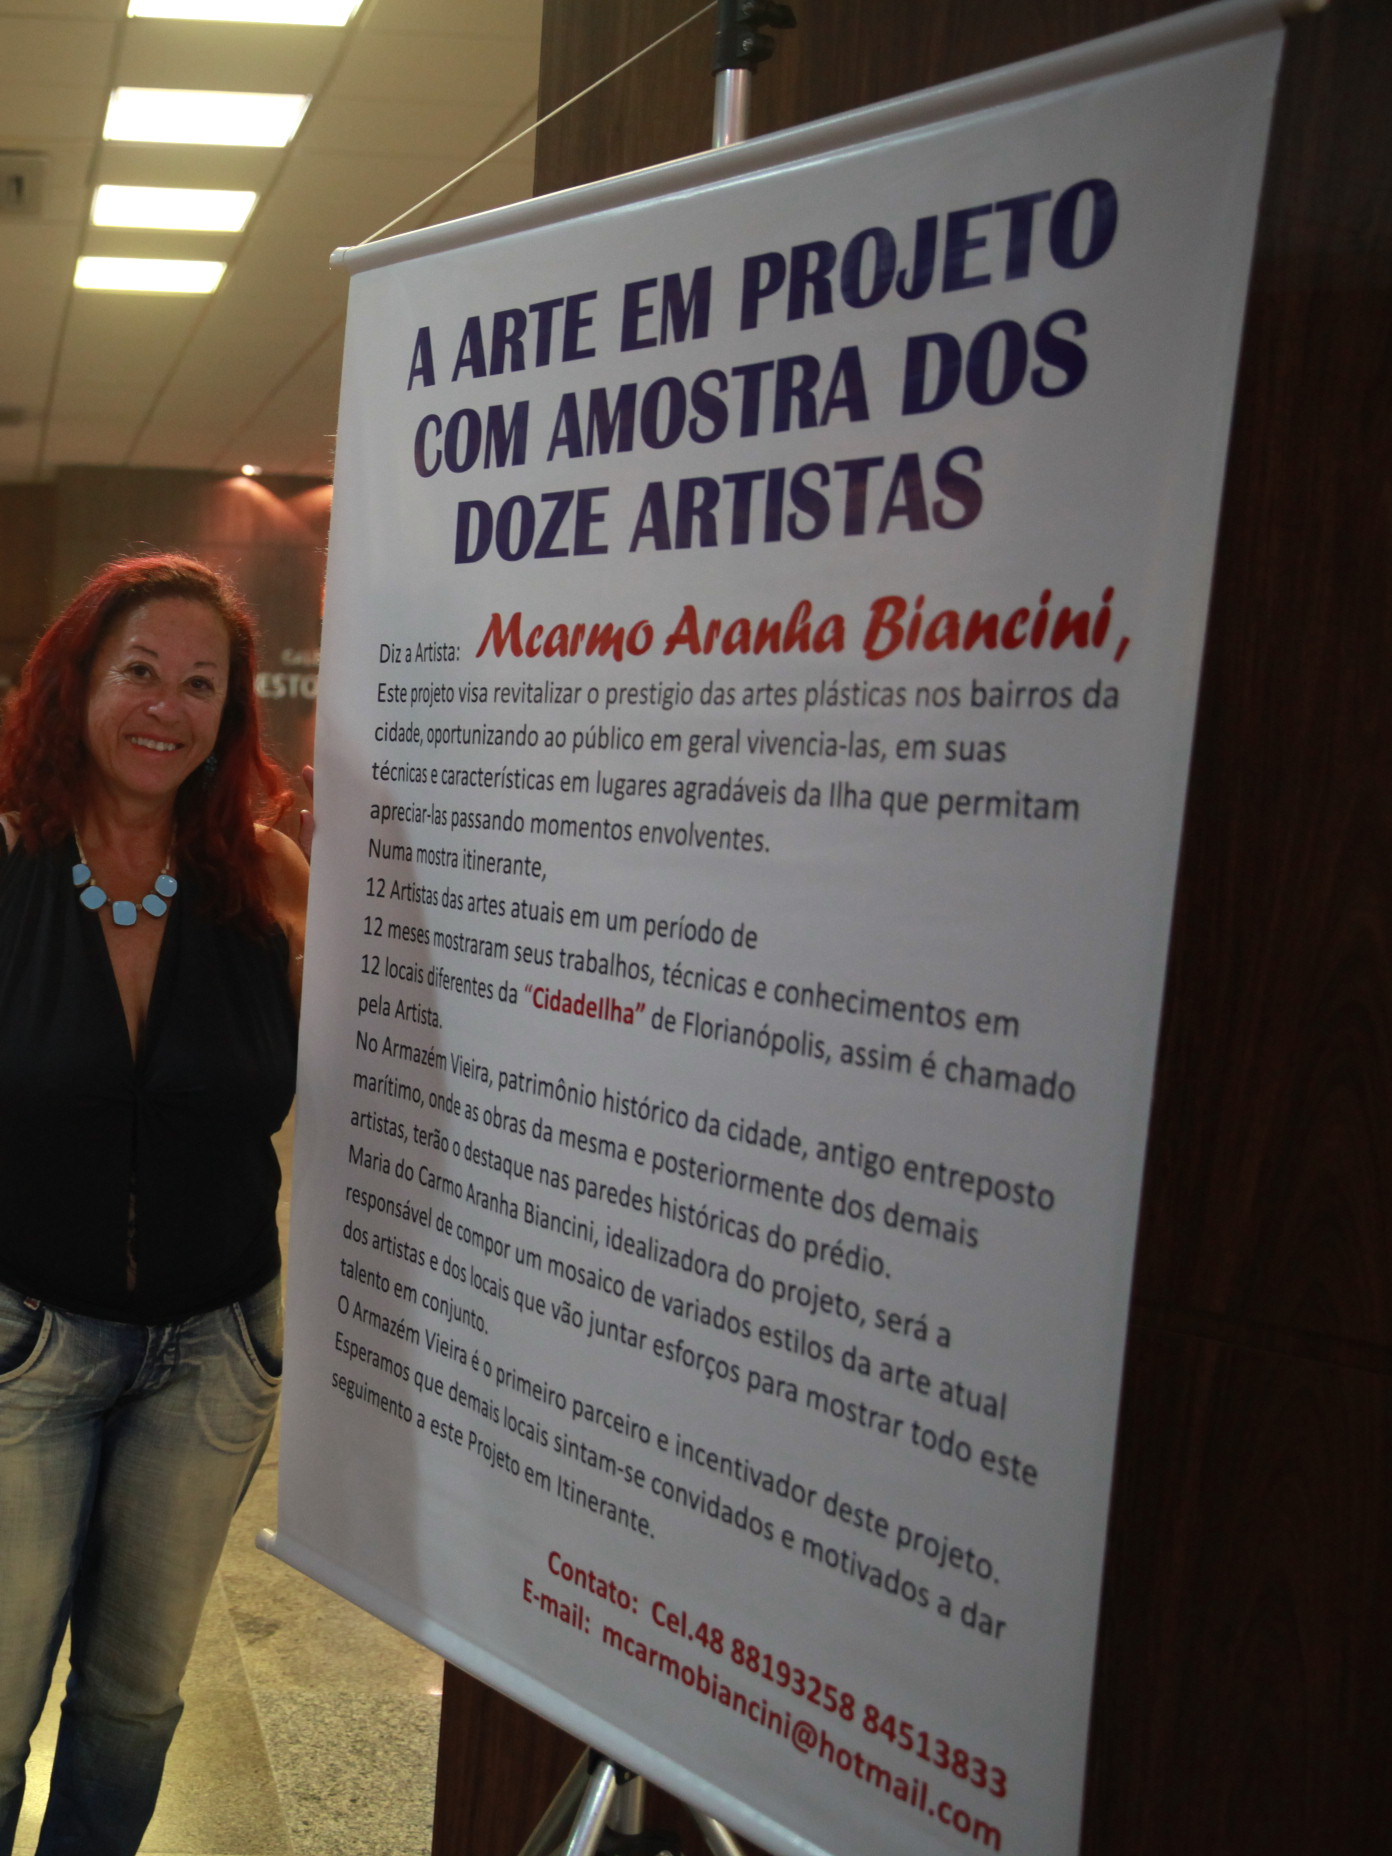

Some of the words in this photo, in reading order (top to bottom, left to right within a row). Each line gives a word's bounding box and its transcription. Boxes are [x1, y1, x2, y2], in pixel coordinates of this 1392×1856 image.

[406, 326, 435, 391] A
[450, 290, 598, 382] ARTE
[619, 265, 712, 352] EM
[739, 178, 1119, 331] PROJETO
[413, 400, 529, 478] COM
[546, 345, 870, 462] AMOSTRA
[900, 308, 1088, 416] DOS
[454, 486, 610, 564] DOZE
[628, 445, 983, 552] ARTISTAS
[377, 683, 407, 703] Este
[410, 682, 454, 708] projeto
[458, 682, 487, 703] visa
[493, 680, 582, 704] revitalizar
[586, 687, 599, 704] o
[605, 682, 693, 711] prestigio
[699, 681, 735, 706] das
[741, 683, 797, 706] artes
[803, 679, 906, 712] plásticas
[915, 687, 961, 708] nos
[970, 679, 1072, 709] bairros
[1082, 678, 1119, 709] da
[379, 643, 401, 663] Diz
[404, 648, 411, 663] a
[414, 642, 460, 662] Artista:
[474, 612, 654, 662] Mcarmo
[662, 599, 845, 656] Aranha
[861, 585, 1130, 663] Biancini,
[371, 760, 427, 783] técnicas
[430, 769, 438, 784] e
[440, 766, 554, 791] características
[559, 775, 589, 793] em
[595, 770, 667, 801] lugares
[672, 776, 786, 805] agradáveis
[793, 780, 821, 807] da
[829, 781, 872, 809] Ilha
[879, 791, 929, 817] que
[936, 790, 1079, 821] permitam
[374, 721, 423, 747] cidade,
[426, 724, 538, 748] oportunizando
[543, 731, 566, 748] ao
[571, 725, 644, 753] público
[649, 733, 682, 751] em
[687, 728, 741, 758] geral
[746, 730, 886, 763] vivencia-las,
[895, 739, 936, 760] em
[944, 740, 1006, 763] suas
[368, 838, 412, 862] Numa
[416, 848, 458, 868] mostra
[462, 848, 546, 882] itinerante,
[369, 803, 447, 826] apreciar-las
[450, 809, 524, 832] passando
[530, 817, 632, 841] momentos
[638, 822, 769, 852] envolventes.
[365, 877, 385, 898] 12
[389, 880, 438, 906] Artistas
[441, 887, 463, 910] das
[467, 895, 505, 916] artes
[510, 900, 564, 924] atuais
[569, 909, 599, 928] em
[606, 914, 637, 933] um
[643, 915, 724, 945] período
[730, 922, 757, 949] de
[357, 994, 390, 1016] pela
[393, 999, 442, 1029] Artista.
[360, 954, 380, 975] 12
[384, 956, 424, 984] locais
[426, 966, 493, 999] diferentes
[497, 980, 517, 1004] da
[650, 1006, 676, 1032] de
[682, 1011, 831, 1065] Florianópolis,
[839, 1044, 912, 1074] assim
[920, 1050, 936, 1079] é
[944, 1056, 1076, 1103] chamado
[350, 1111, 408, 1143] artistas,
[412, 1124, 449, 1152] terão
[452, 1141, 460, 1157] o
[463, 1140, 534, 1181] destaque
[538, 1168, 569, 1191] nas
[574, 1178, 652, 1214] paredes
[658, 1193, 759, 1243] históricas
[766, 1224, 796, 1253] do
[803, 1239, 890, 1279] prédio.
[352, 1073, 424, 1108] marítimo,
[428, 1092, 461, 1116] onde
[464, 1104, 479, 1122] as
[482, 1105, 526, 1135] obras
[531, 1117, 552, 1142] da
[558, 1129, 627, 1161] mesma
[633, 1147, 646, 1165] e
[651, 1152, 823, 1210] posteriormente
[831, 1190, 875, 1223] dos
[882, 1202, 978, 1248] demais
[355, 1030, 378, 1053] No
[380, 1036, 446, 1070] Armazém
[450, 1053, 493, 1088] Vieira,
[497, 1071, 596, 1108] patrimônio
[602, 1088, 688, 1129] histórico
[694, 1109, 720, 1136] da
[726, 1118, 807, 1160] cidade,
[815, 1141, 895, 1178] antigo
[902, 1160, 1055, 1211] entreposto
[339, 1258, 390, 1293] talento
[393, 1282, 417, 1304] em
[421, 1293, 488, 1335] conjunto.
[348, 1144, 390, 1174] Maria
[394, 1158, 414, 1181] do
[418, 1165, 462, 1199] Carmo
[465, 1183, 518, 1219] Aranha
[523, 1202, 598, 1248] Biancini,
[605, 1225, 728, 1283] idealizadora
[735, 1264, 764, 1293] do
[771, 1280, 865, 1328] projeto,
[874, 1309, 928, 1341] será
[935, 1327, 951, 1348] a
[342, 1220, 368, 1245] dos
[371, 1234, 425, 1266] artistas
[429, 1255, 438, 1271] e
[442, 1256, 466, 1283] dos
[469, 1265, 509, 1301] locais
[513, 1290, 545, 1315] que
[550, 1301, 583, 1328] vão
[586, 1310, 647, 1349] juntar
[652, 1338, 739, 1383] esforços
[746, 1370, 798, 1403] para
[805, 1389, 904, 1437] mostrar
[910, 1421, 972, 1462] todo
[979, 1450, 1038, 1487] este
[331, 1373, 412, 1422] seguimento
[416, 1413, 425, 1429] a
[429, 1419, 463, 1446] este
[467, 1430, 520, 1476] Projeto
[524, 1466, 551, 1492] em
[556, 1475, 654, 1539] Itinerante.
[334, 1331, 410, 1381] Esperamos
[413, 1371, 443, 1396] que
[448, 1381, 499, 1423] demais
[503, 1406, 548, 1447] locais
[553, 1433, 645, 1488] sintam-se
[650, 1477, 774, 1541] convidados
[780, 1530, 795, 1550] e
[801, 1538, 929, 1608] motivados
[936, 1596, 952, 1618] a
[960, 1602, 1006, 1639] dar
[522, 1578, 590, 1634] E-mail:
[601, 1625, 1002, 1852] mcarmobiancini@hotmail.com
[547, 1551, 638, 1614] Contato:
[651, 1601, 724, 1655] Cel.48
[729, 1638, 856, 1722] 88193258
[861, 1704, 1007, 1800] 84513833
